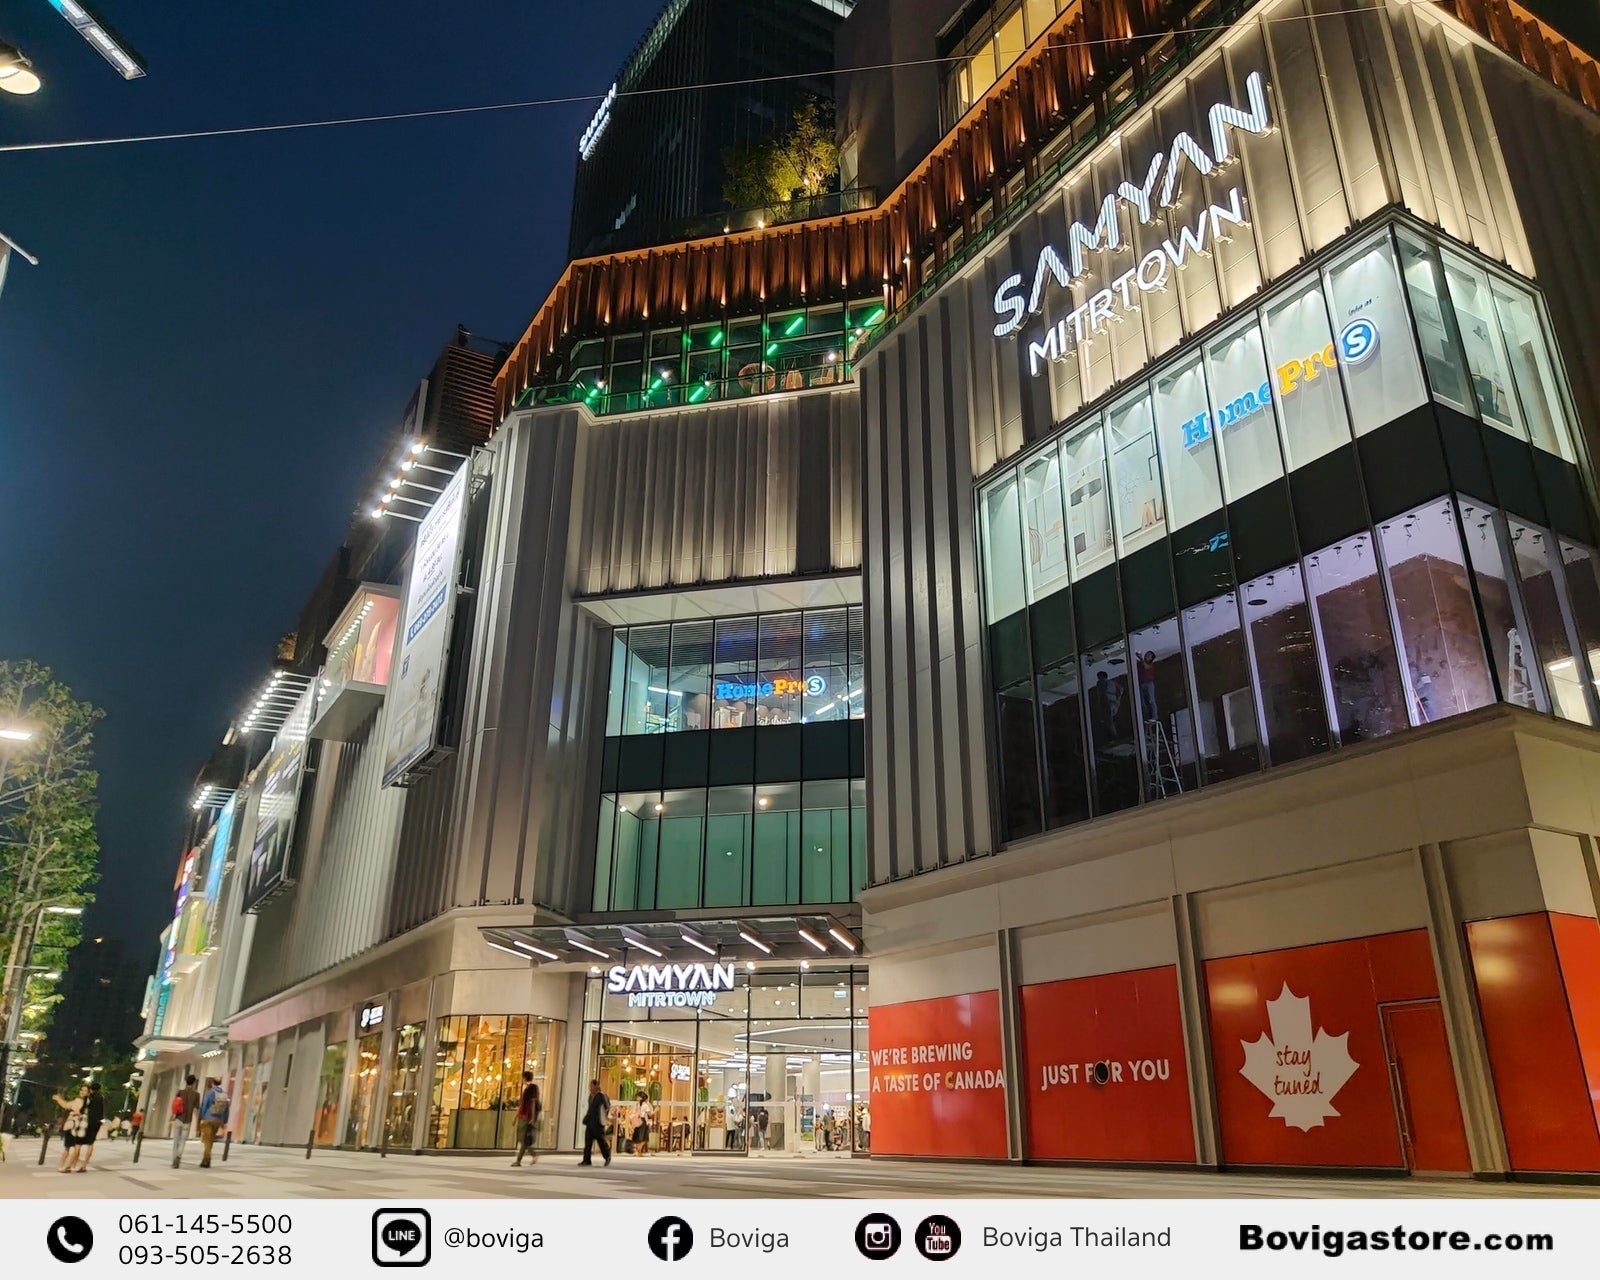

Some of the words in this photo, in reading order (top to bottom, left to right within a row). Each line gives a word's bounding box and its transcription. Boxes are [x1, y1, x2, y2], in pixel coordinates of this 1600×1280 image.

[993, 71, 1268, 337] SAMYAN
[1028, 187, 1242, 377] MITRTOWN
[608, 963, 735, 992] SAMYAN
[628, 991, 714, 1008] MITRTOWN
[871, 1047, 908, 1066] WE'RE
[911, 1042, 973, 1064] BREWING
[1276, 1045, 1311, 1077] stay
[872, 1076, 881, 1093] A
[884, 1073, 919, 1092] TASTE
[923, 1072, 941, 1091] OF
[945, 1069, 1006, 1091] CANADA
[1041, 1064, 1079, 1091] JUST
[1085, 1060, 1124, 1085] FOR
[1128, 1060, 1170, 1081] YOU
[1274, 1072, 1323, 1095] tuned
